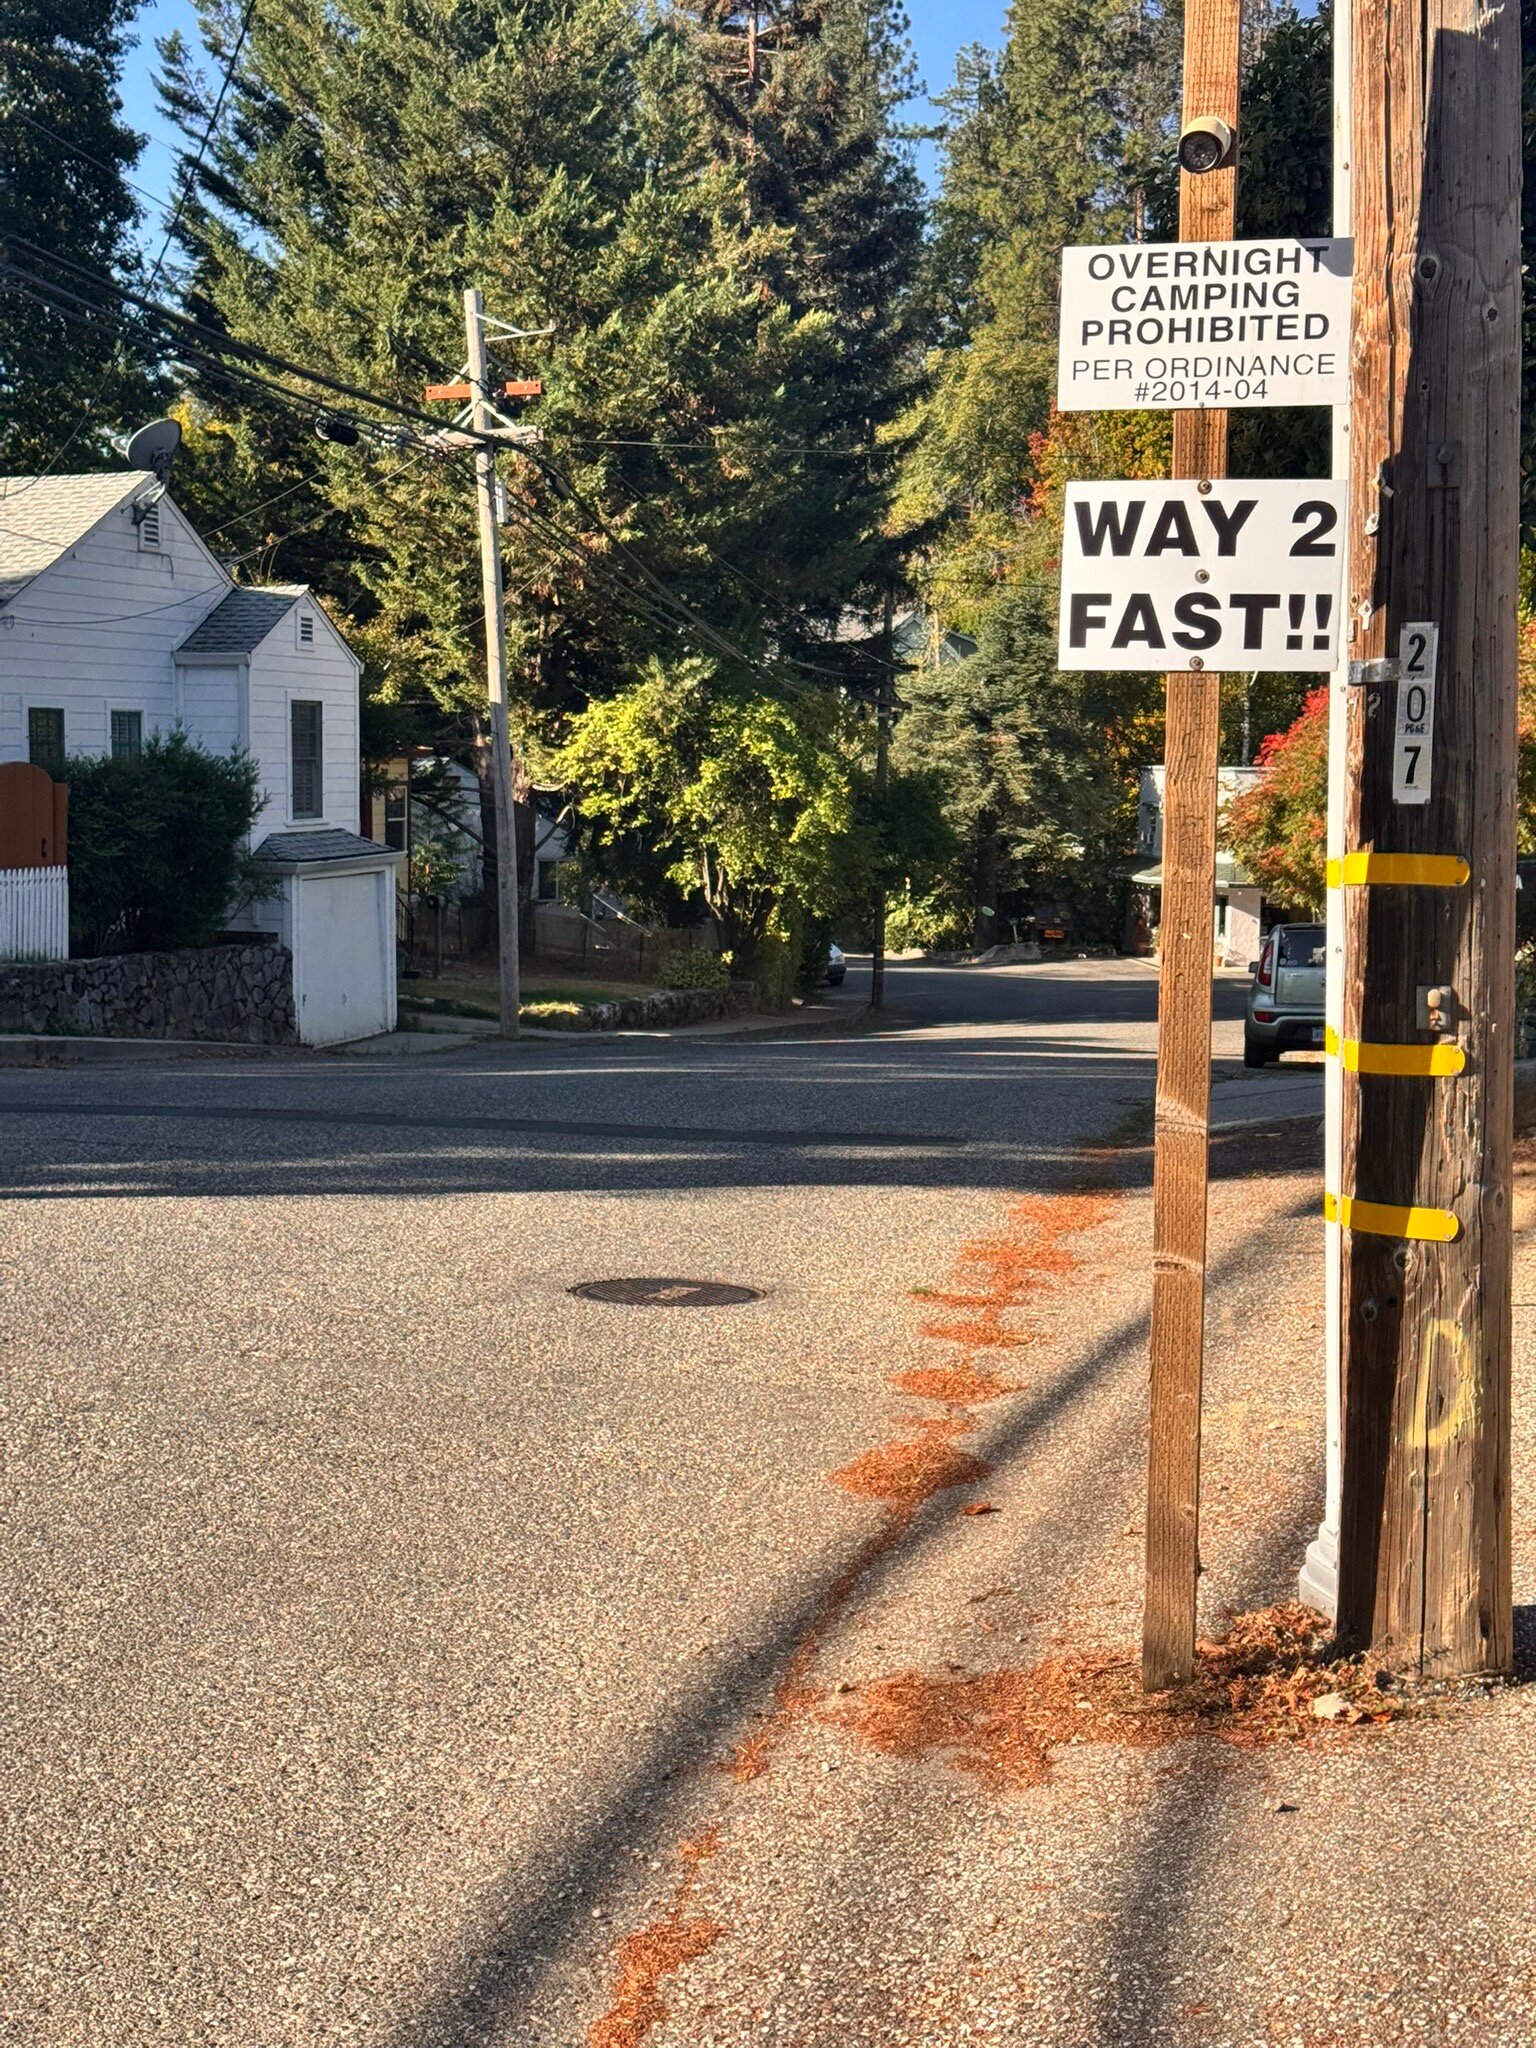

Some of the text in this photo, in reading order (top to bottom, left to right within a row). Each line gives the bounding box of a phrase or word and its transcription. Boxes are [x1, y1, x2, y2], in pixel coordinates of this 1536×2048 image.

[1088, 246, 1329, 280] OVERNIGHT
[1111, 280, 1300, 313] CAMPING
[1081, 313, 1330, 346] PROHIBITED
[1072, 353, 1336, 381] PER ORDINANCE
[1134, 379, 1269, 402] #2014-04
[1074, 500, 1338, 557] WAY 2
[1069, 591, 1333, 651] FAST!!
